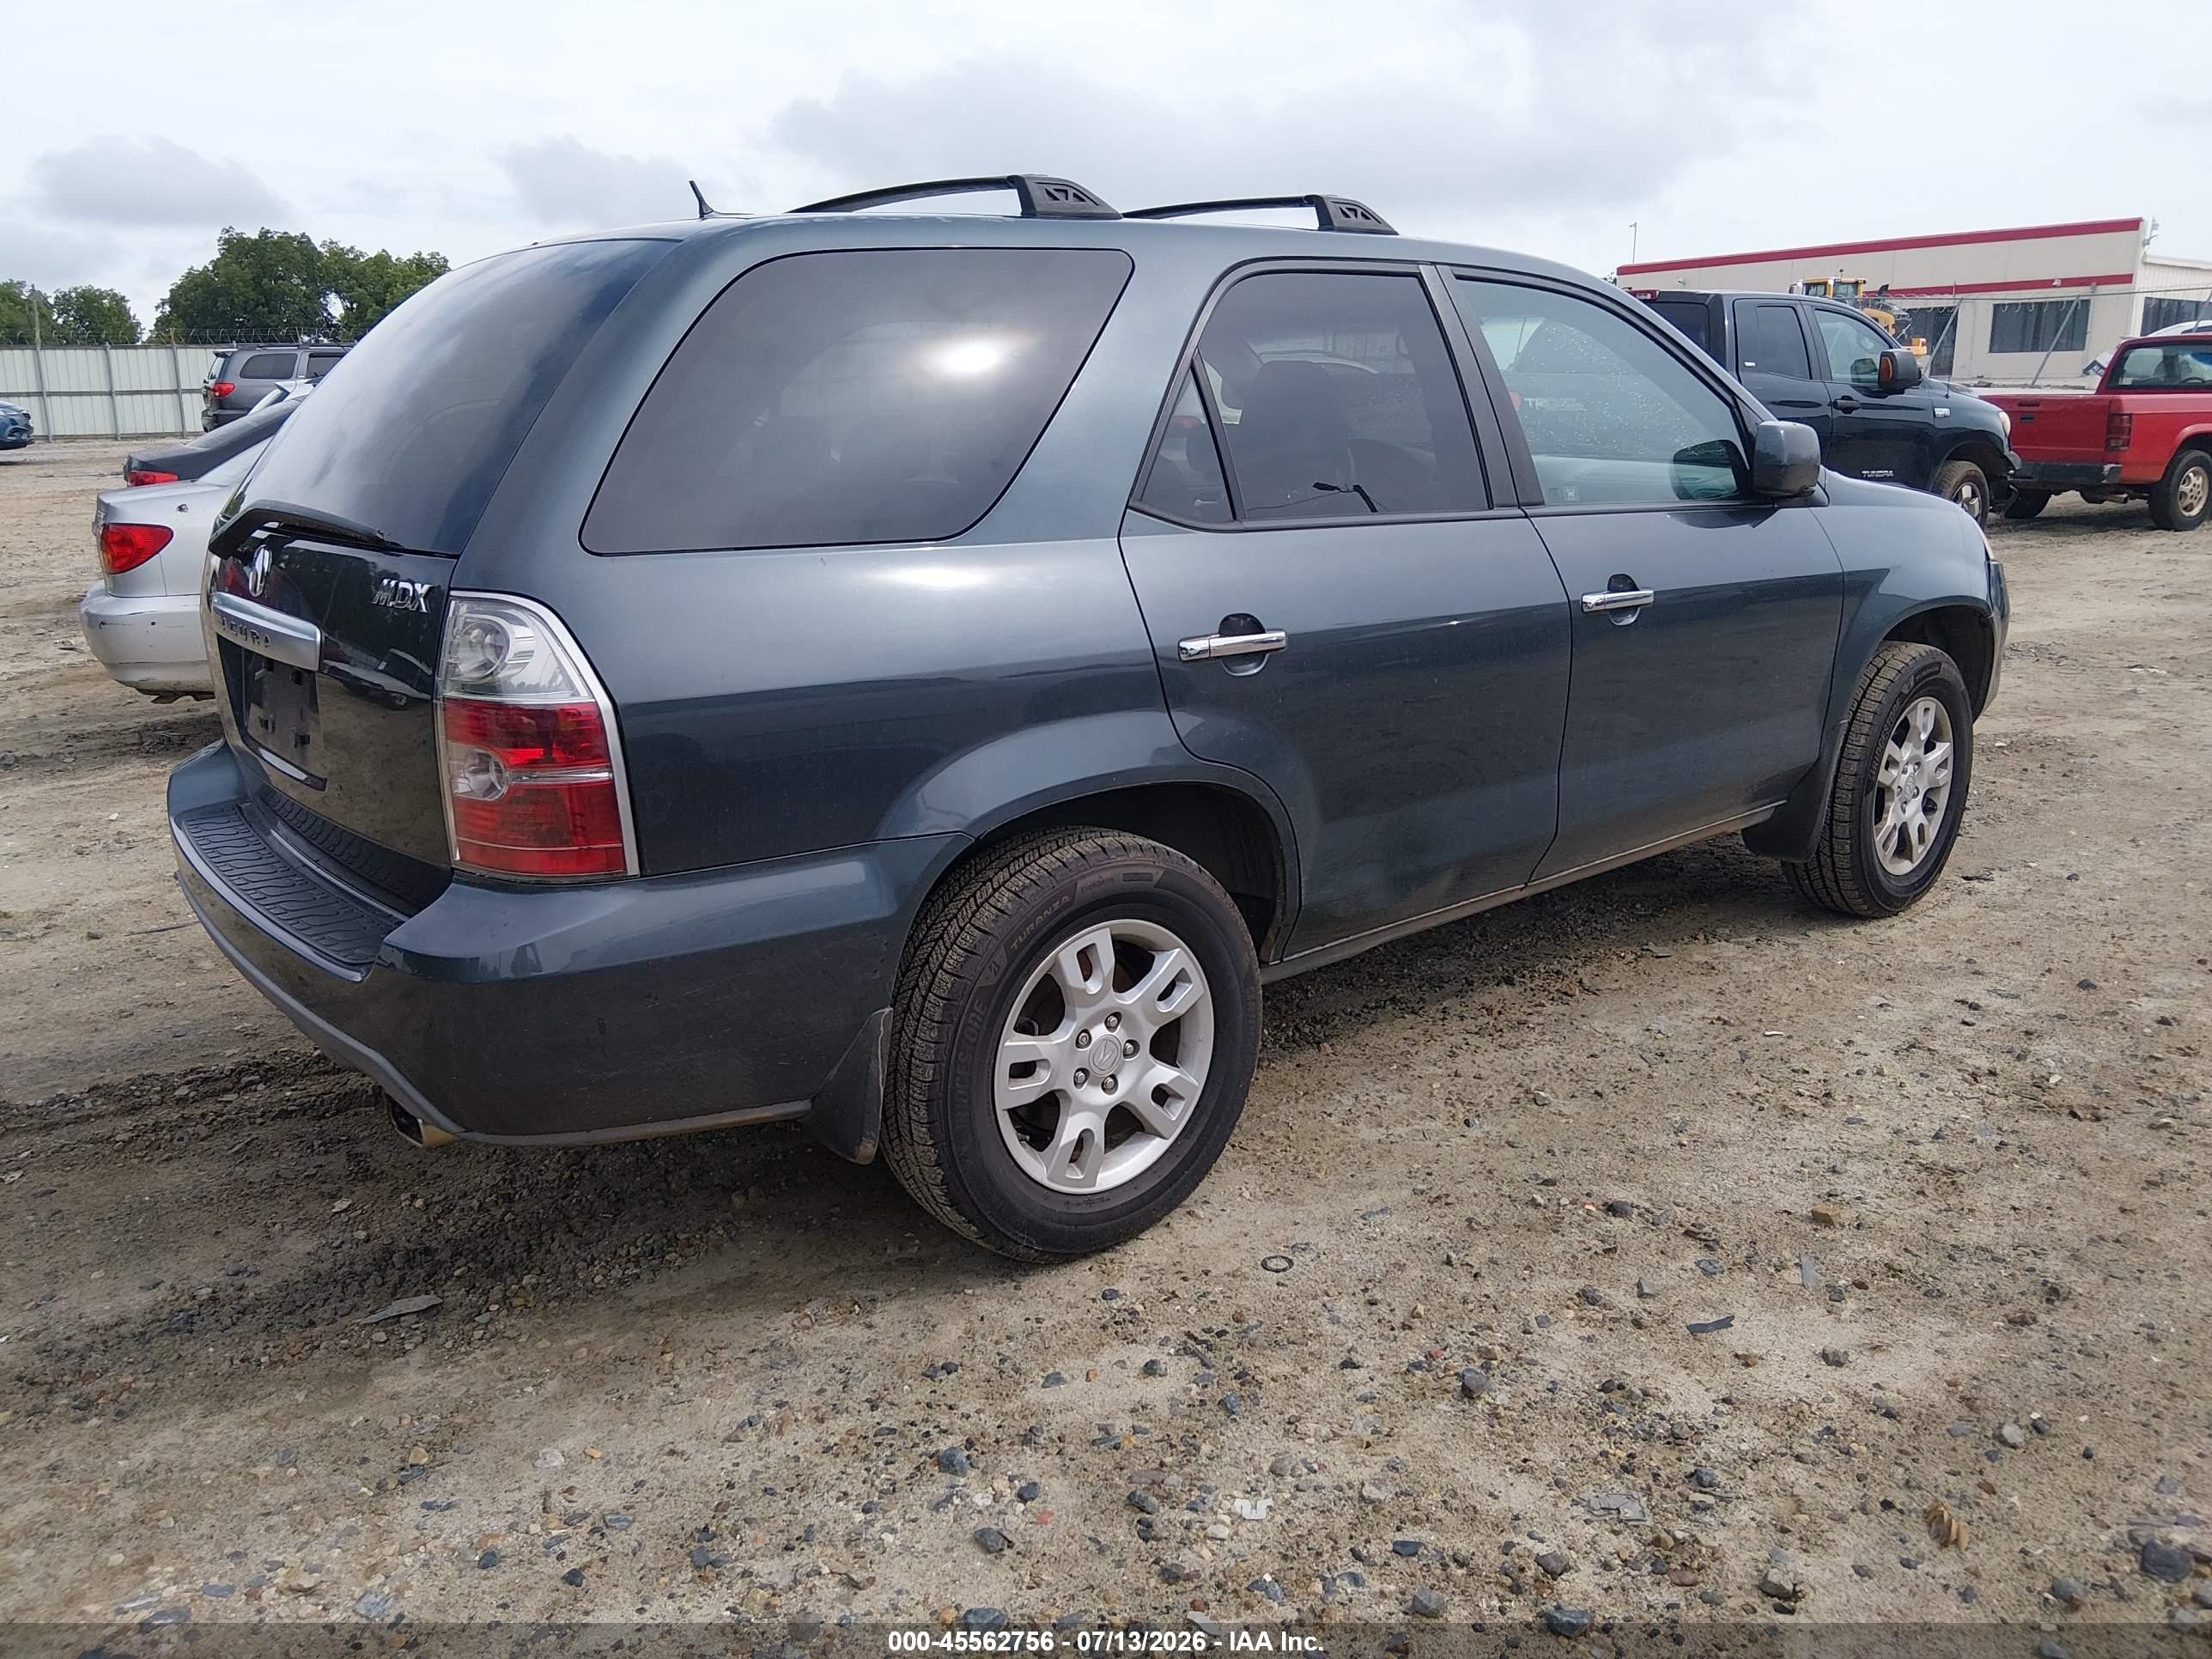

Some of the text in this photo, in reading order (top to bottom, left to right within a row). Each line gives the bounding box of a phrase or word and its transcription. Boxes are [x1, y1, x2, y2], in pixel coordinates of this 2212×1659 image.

[371, 578, 434, 613] MDX
[1011, 896, 1072, 951] TURANZA
[954, 998, 988, 1140] IDGESTONE
